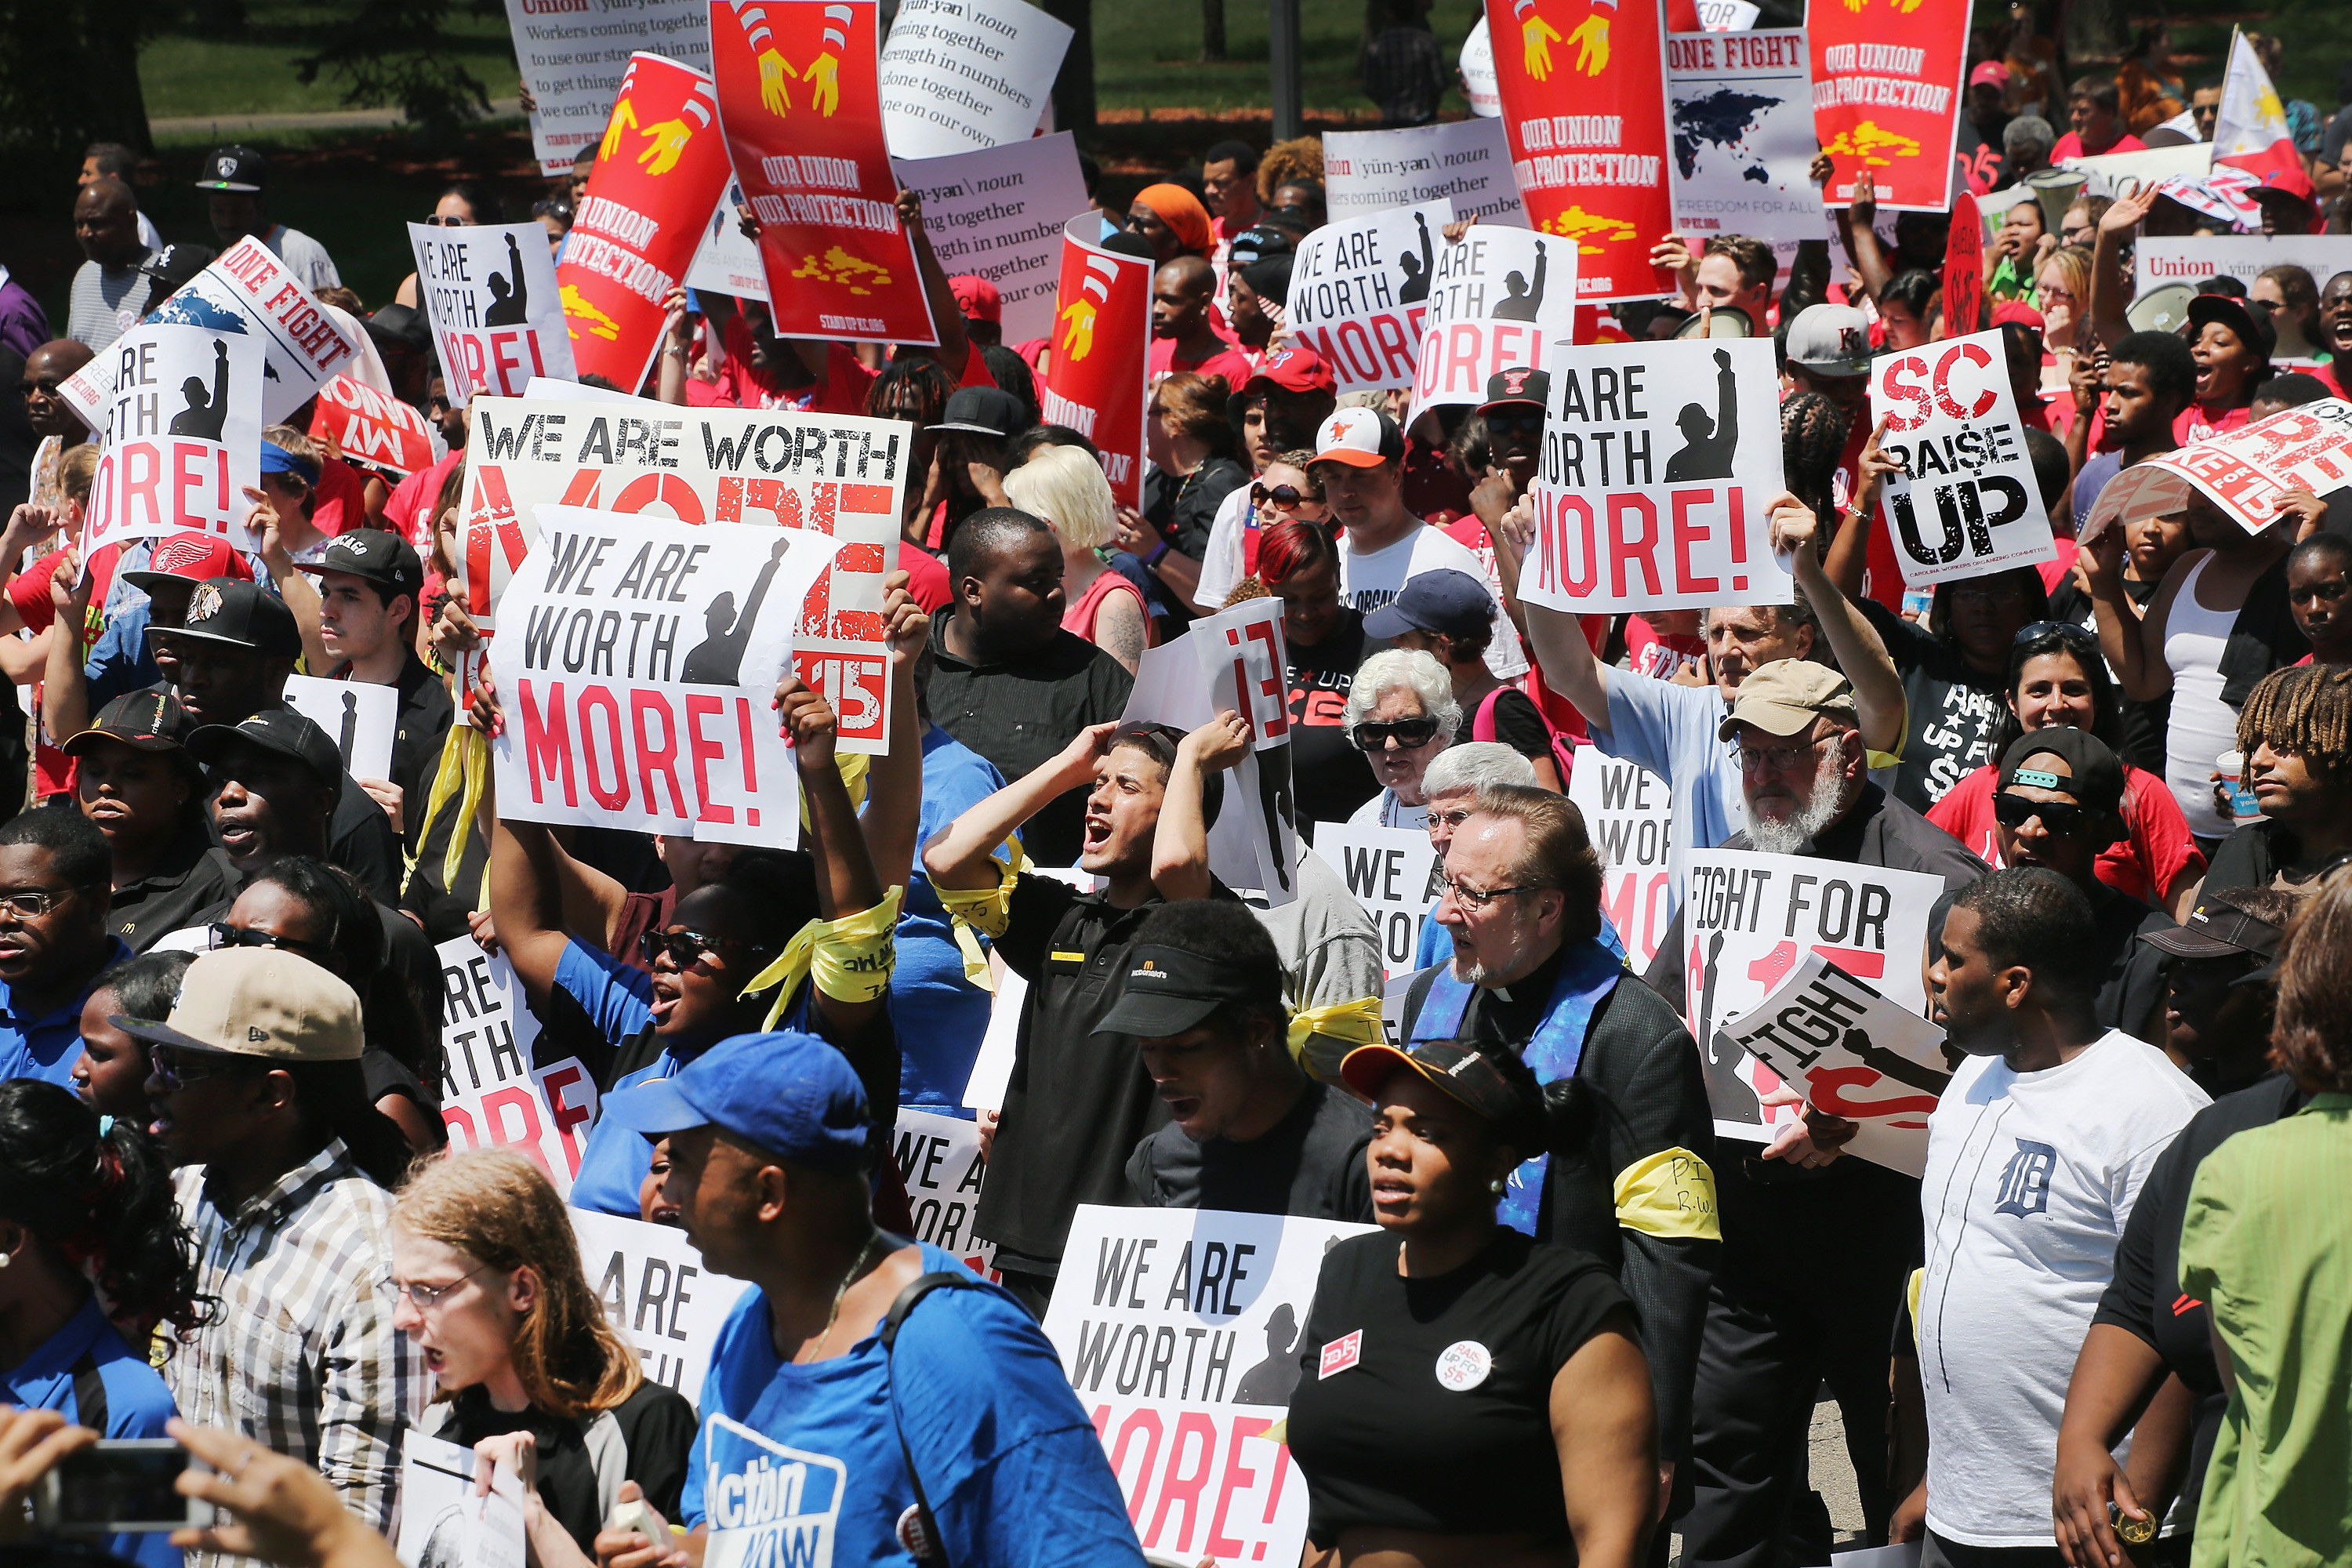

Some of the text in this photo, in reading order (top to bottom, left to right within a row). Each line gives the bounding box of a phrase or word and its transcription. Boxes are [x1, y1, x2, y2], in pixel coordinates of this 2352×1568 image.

[527, 13, 708, 40] Workers coming togethe
[931, 24, 1004, 63] together
[975, 13, 1018, 41] noun
[532, 53, 546, 67] to
[549, 53, 573, 66] use
[575, 52, 600, 64] our
[602, 41, 667, 62] streth
[670, 41, 686, 56] in
[1668, 35, 1802, 72] ONE FIGHT
[1824, 42, 1926, 76] OUR UNION
[536, 80, 549, 93] to
[553, 78, 573, 95] get
[882, 71, 993, 117] done together
[938, 53, 956, 73] in
[960, 63, 1033, 111] numbers
[1835, 76, 1952, 115] PROTECTION
[541, 105, 561, 118] we
[564, 101, 600, 117] can't
[903, 102, 926, 118] on
[929, 110, 960, 132] our
[961, 124, 996, 147] own
[1520, 115, 1624, 152] OUR UNION
[760, 155, 861, 191] OUR UNION
[1444, 147, 1490, 167] noun
[1533, 153, 1661, 189] PROTECTION
[977, 172, 1025, 193] noun
[1352, 187, 1410, 206] coming
[1414, 176, 1490, 201] together
[589, 196, 659, 252] UNION
[751, 194, 789, 227] OUR
[786, 194, 899, 234] PROTECTION
[947, 201, 1026, 228] together
[1457, 196, 1521, 223] numbe
[1677, 199, 1818, 215] FREEDOM FOR ALL
[441, 243, 471, 282] ARE
[973, 236, 993, 253] in
[1298, 228, 1383, 283] WE ARE
[1437, 241, 1487, 284] ARE
[2149, 256, 2215, 276] Union
[223, 243, 353, 372] ONE FIGHT
[1000, 287, 1030, 306] our
[1294, 272, 1393, 325] WORTH
[1562, 365, 1649, 423] ARE
[1882, 343, 1998, 433] SC
[481, 412, 900, 481] WE ARE WORTH
[88, 441, 230, 545] ORE!
[2211, 466, 2253, 490] FOR
[1891, 474, 2028, 565] UP
[543, 532, 710, 603] WE ARE
[1909, 546, 2049, 579] CAROLINA WORKERS ORGANIZING COMMITTEE
[524, 605, 681, 682] WORTH
[517, 678, 761, 827] MORE!
[1922, 722, 1964, 750] UP
[1601, 764, 1650, 810] WE
[1344, 846, 1405, 902] WE
[1692, 866, 1892, 950] FIGHT FOR
[1736, 960, 1882, 1082] FIGHT
[892, 1129, 951, 1190] WE
[597, 1250, 698, 1341] ARE
[1093, 1237, 1257, 1316] WE ARE
[1073, 1319, 1236, 1403] WORTH
[1443, 1365, 1468, 1384] $15
[1444, 1352, 1484, 1378] UP FOR
